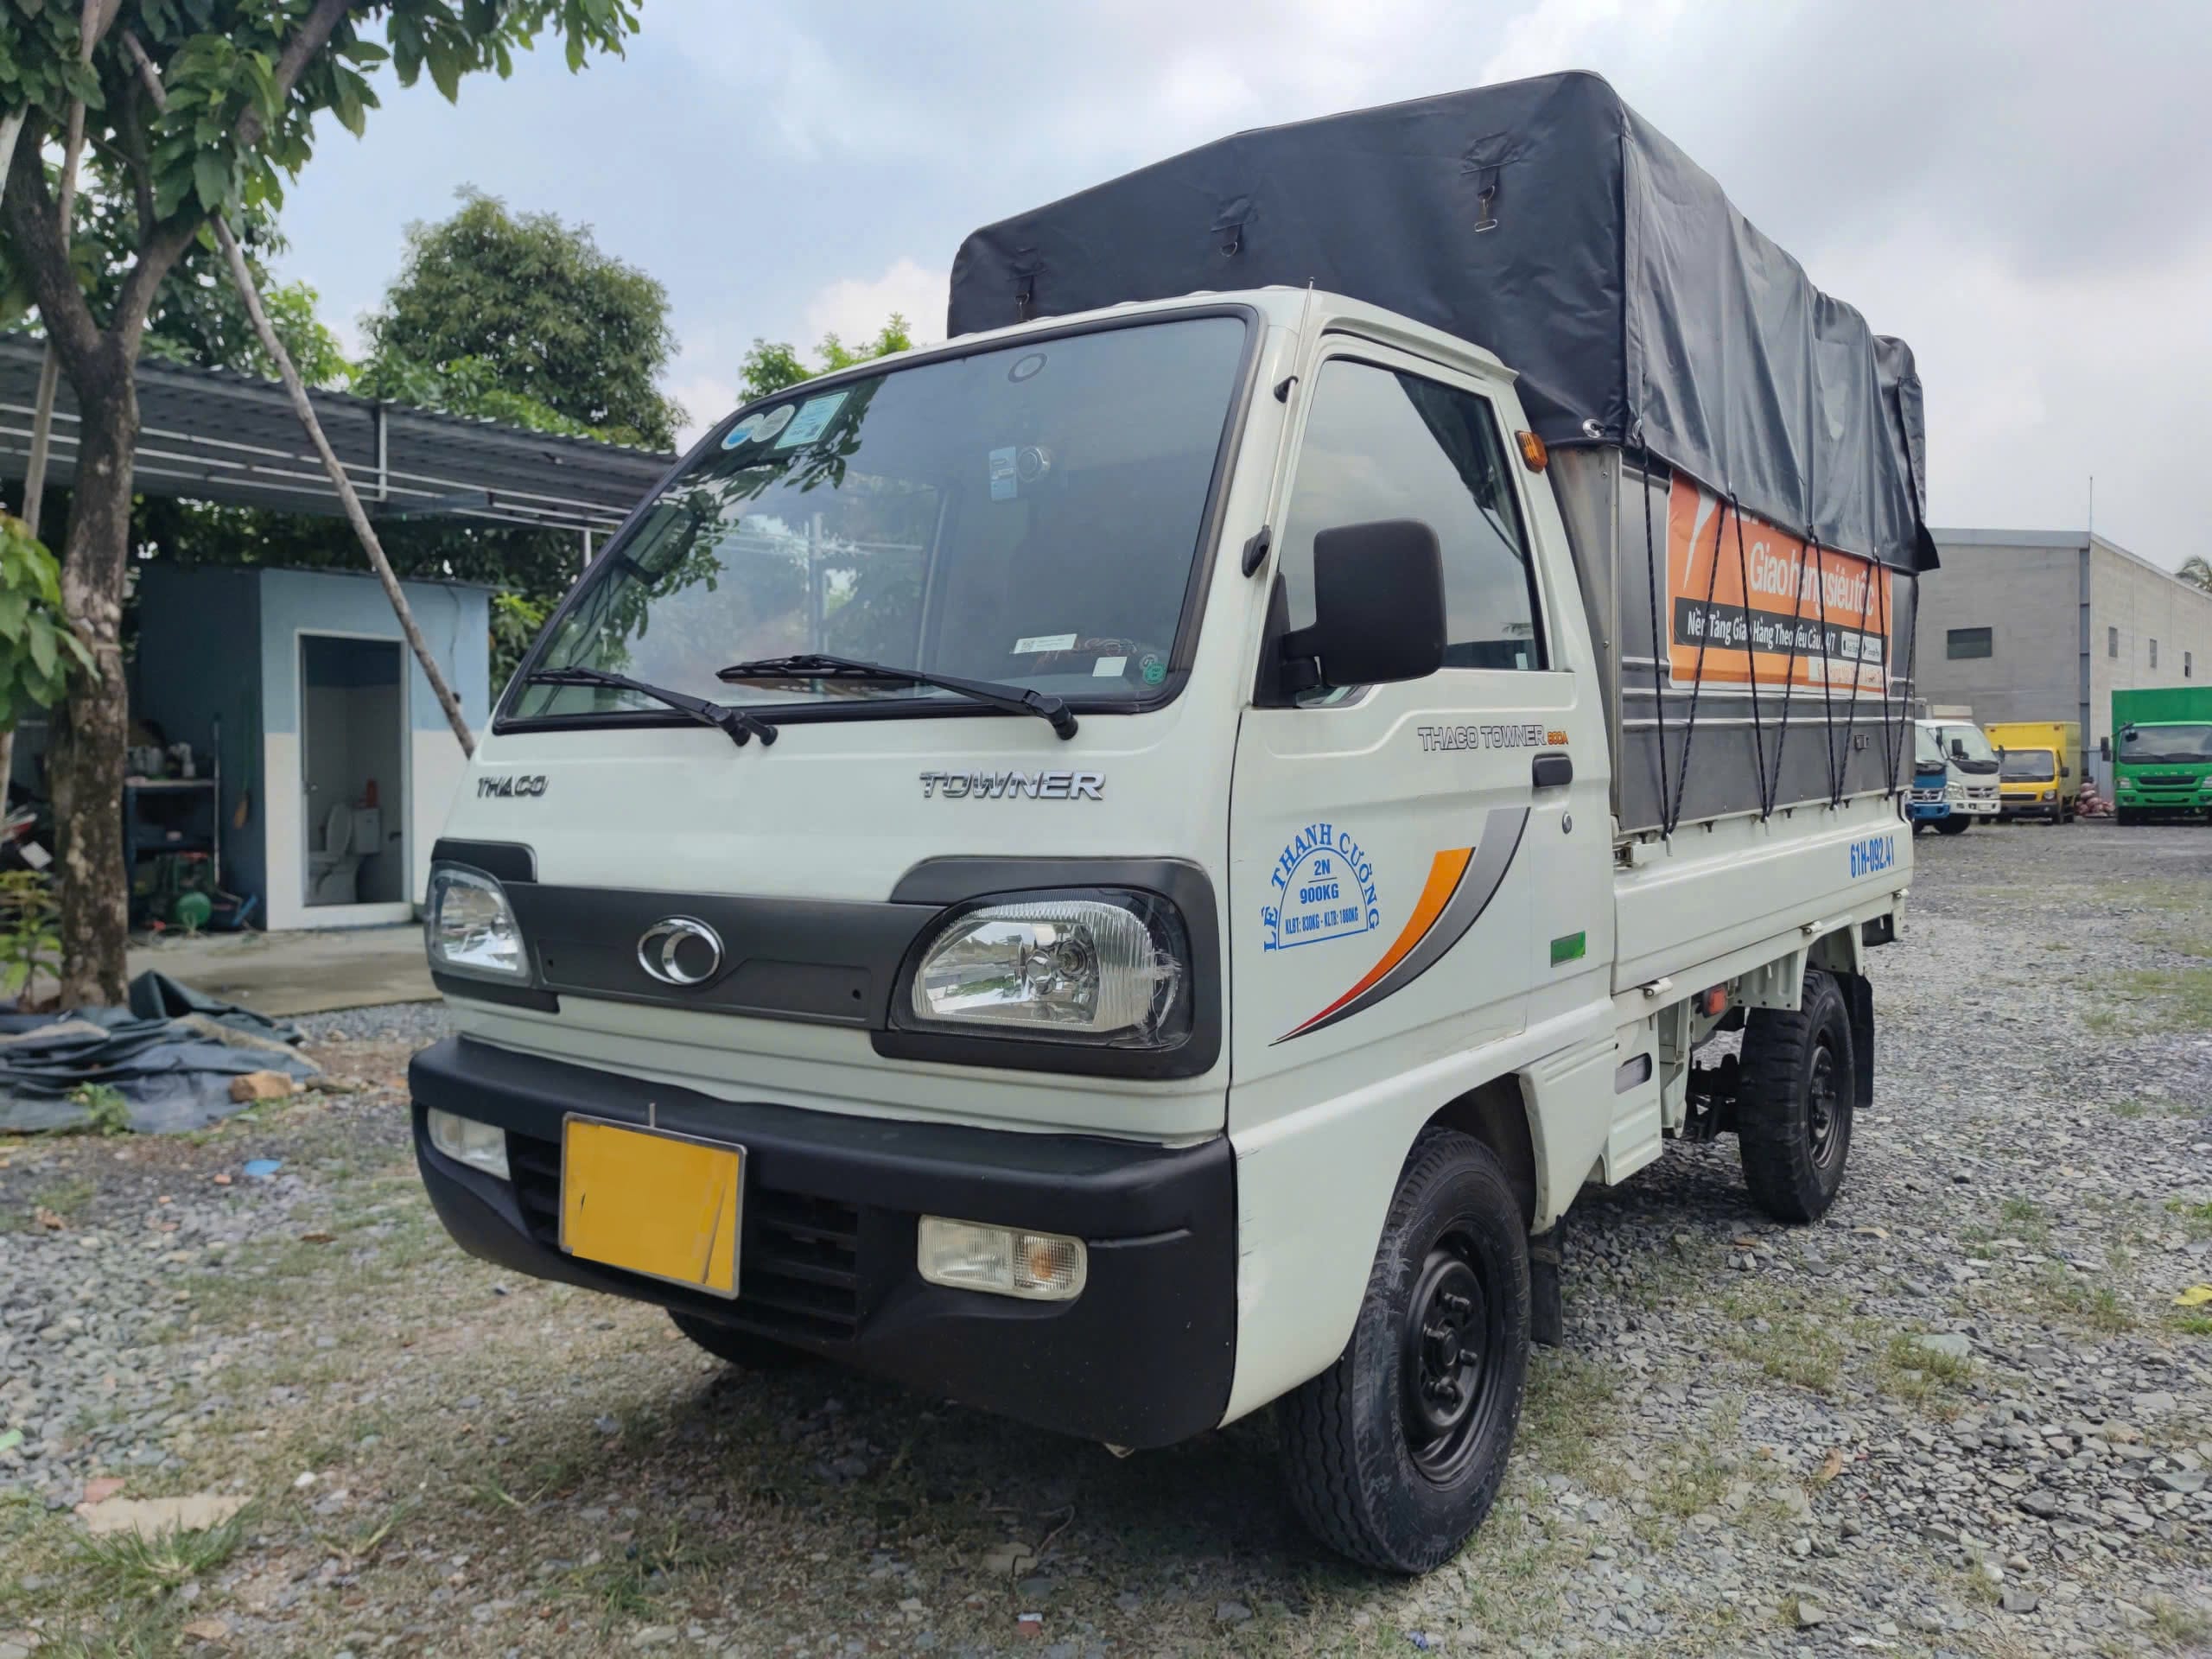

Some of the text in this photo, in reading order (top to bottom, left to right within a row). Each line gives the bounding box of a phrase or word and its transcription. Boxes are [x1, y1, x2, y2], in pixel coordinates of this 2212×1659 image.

[1749, 541, 1788, 596] Giao
[1709, 609, 1732, 646] Tảng
[1732, 615, 1752, 641] Gia
[1752, 615, 1775, 650] Hàng
[1775, 622, 1795, 647] Theo
[1821, 631, 1836, 656] 4/7
[1417, 725, 1479, 752] THACO
[1480, 724, 1547, 749] TOWNER
[477, 775, 550, 798] THACO
[918, 769, 1106, 801] TOWNER
[1313, 859, 1332, 876] 2N
[1850, 834, 1895, 879] 61H-092.41
[1271, 823, 1332, 891] THANH
[1339, 832, 1380, 931] CƯỜNG
[1300, 883, 1339, 905] 900KG
